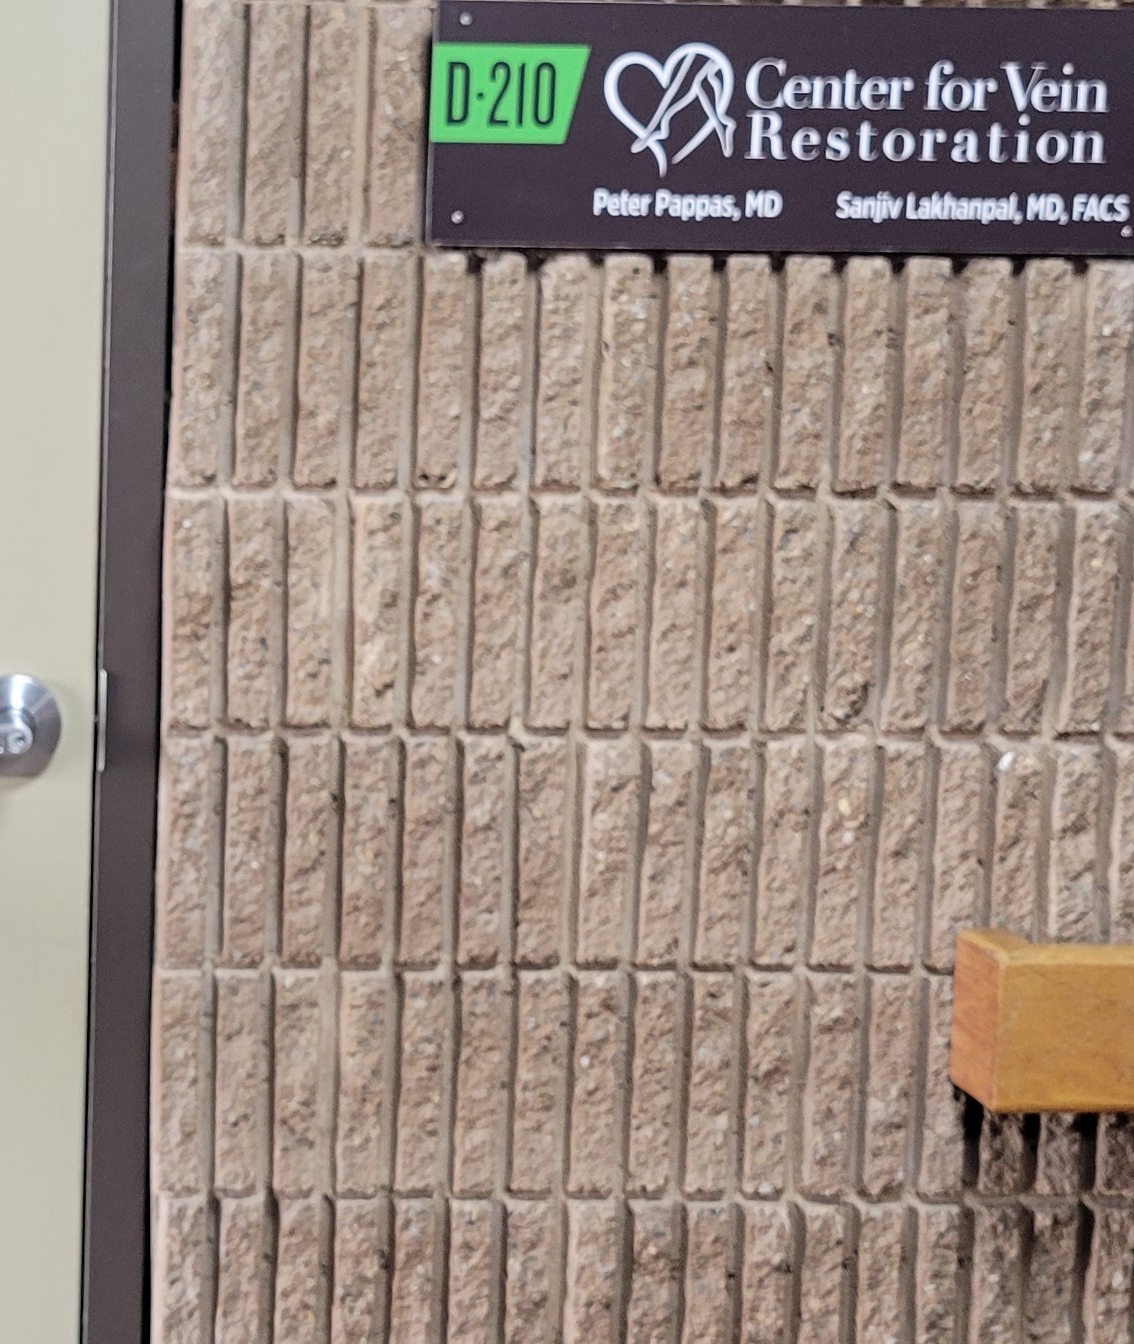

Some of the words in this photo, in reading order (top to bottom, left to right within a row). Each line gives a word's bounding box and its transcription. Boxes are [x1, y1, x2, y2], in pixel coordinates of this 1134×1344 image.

[745, 57, 914, 111] Center
[923, 59, 998, 112] for
[1000, 61, 1109, 113] Vein
[744, 109, 1107, 164] Restoration
[593, 187, 652, 217] Peter
[655, 188, 742, 222] Pappas,
[745, 189, 784, 219] MD
[835, 190, 903, 224] Sanjiv
[906, 191, 1023, 225] Lakhanpal,
[1026, 193, 1067, 226] MD,
[1072, 193, 1132, 224] FACS
